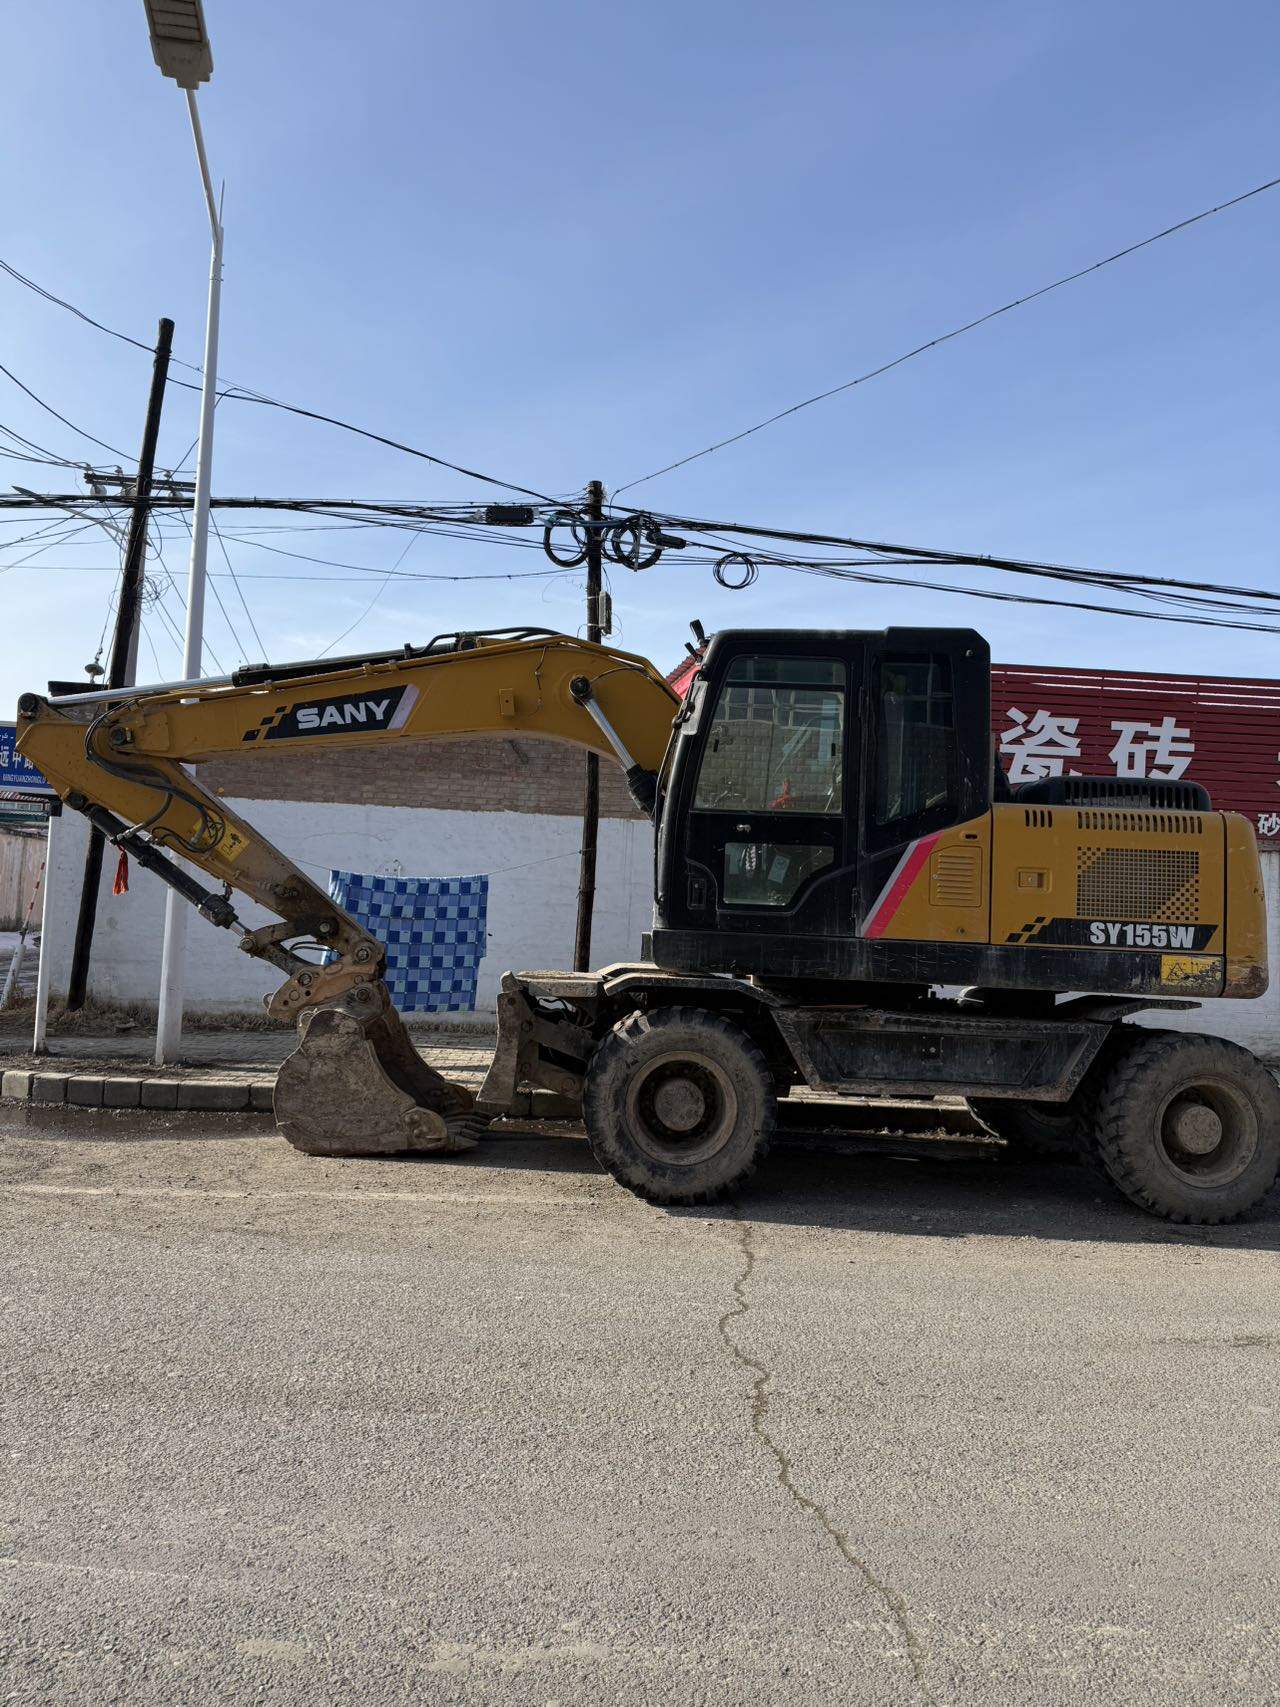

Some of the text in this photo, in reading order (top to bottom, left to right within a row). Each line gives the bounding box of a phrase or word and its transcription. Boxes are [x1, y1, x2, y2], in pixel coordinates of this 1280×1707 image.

[296, 699, 390, 729] SANY
[1000, 706, 1195, 784] 瓷砖
[1258, 813, 1280, 836] 砂
[1089, 921, 1195, 948] SY155W
